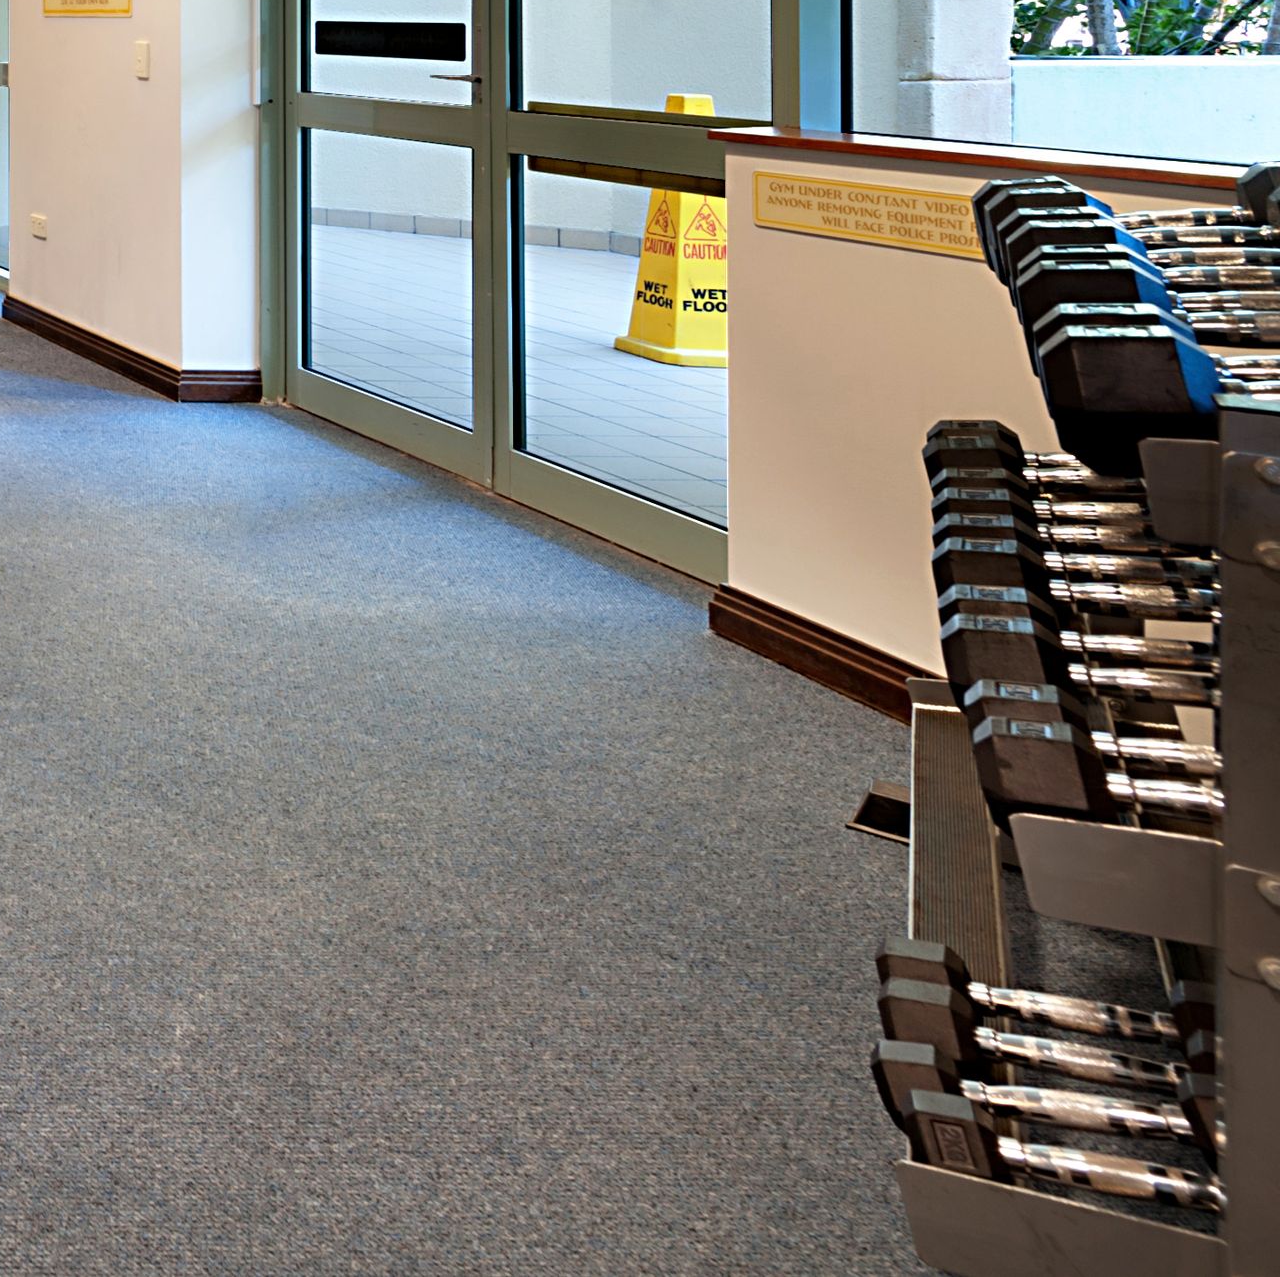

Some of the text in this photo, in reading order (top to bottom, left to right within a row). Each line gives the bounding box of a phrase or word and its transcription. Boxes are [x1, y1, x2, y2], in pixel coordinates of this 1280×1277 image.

[769, 181, 970, 217] GYM UNDER CONSTANT VIDEO
[766, 195, 813, 211] ANYONE
[817, 200, 882, 220] REMOVING
[887, 209, 964, 232] EQUIPMENT
[821, 215, 851, 230] WILL
[855, 220, 885, 235] FACE
[890, 225, 935, 242] POLICE
[644, 237, 676, 258] CAUTION
[643, 280, 669, 295] WET
[636, 290, 674, 310] FLOOR
